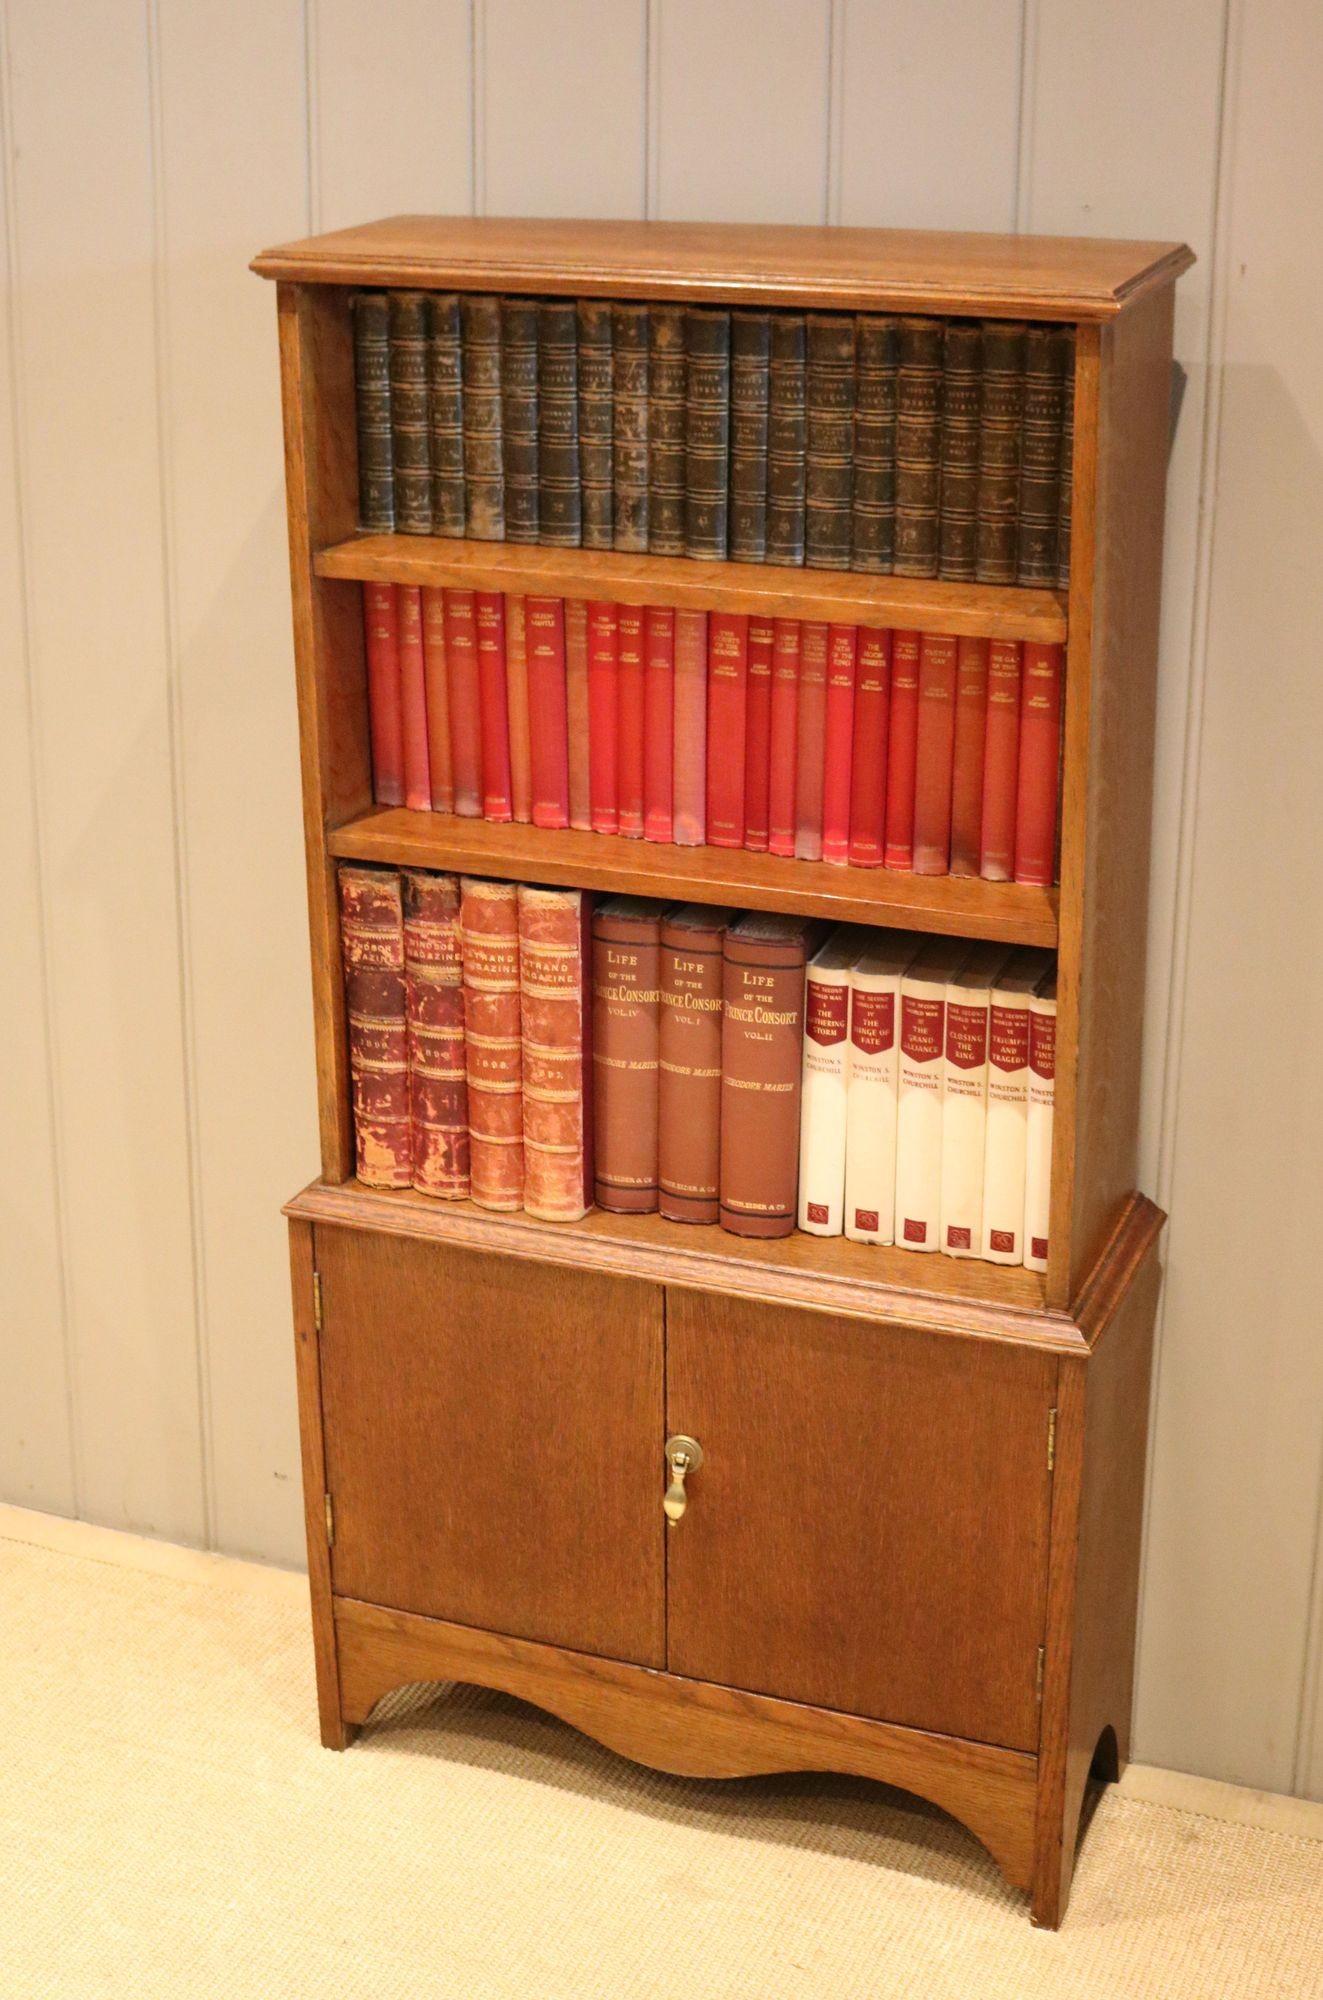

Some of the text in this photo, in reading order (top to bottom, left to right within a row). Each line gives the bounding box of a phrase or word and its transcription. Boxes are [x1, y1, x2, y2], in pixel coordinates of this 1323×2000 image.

[607, 950, 638, 966] LIFE
[673, 957, 704, 974] LIFE
[621, 973, 637, 982] THE
[743, 972, 774, 987] LIFE
[687, 981, 702, 989] THE
[619, 985, 660, 1003] CONSORT
[743, 993, 773, 1003] OF THE
[685, 992, 723, 1011] CONSOR
[724, 1000, 797, 1025] PRINCE CONSORT
[863, 1019, 879, 1027] THE
[913, 1026, 928, 1034] THE
[949, 1031, 983, 1042] CLOSING
[861, 1037, 880, 1046] FATE
[958, 1042, 972, 1051] THE
[1001, 1046, 1017, 1055] AND
[955, 1051, 975, 1060] RING
[948, 1077, 975, 1087] WINSTON
[947, 1087, 981, 1096] CHURCHILL
[990, 1083, 1019, 1092] WINSTON
[989, 1092, 1027, 1102] CHURCHILL
